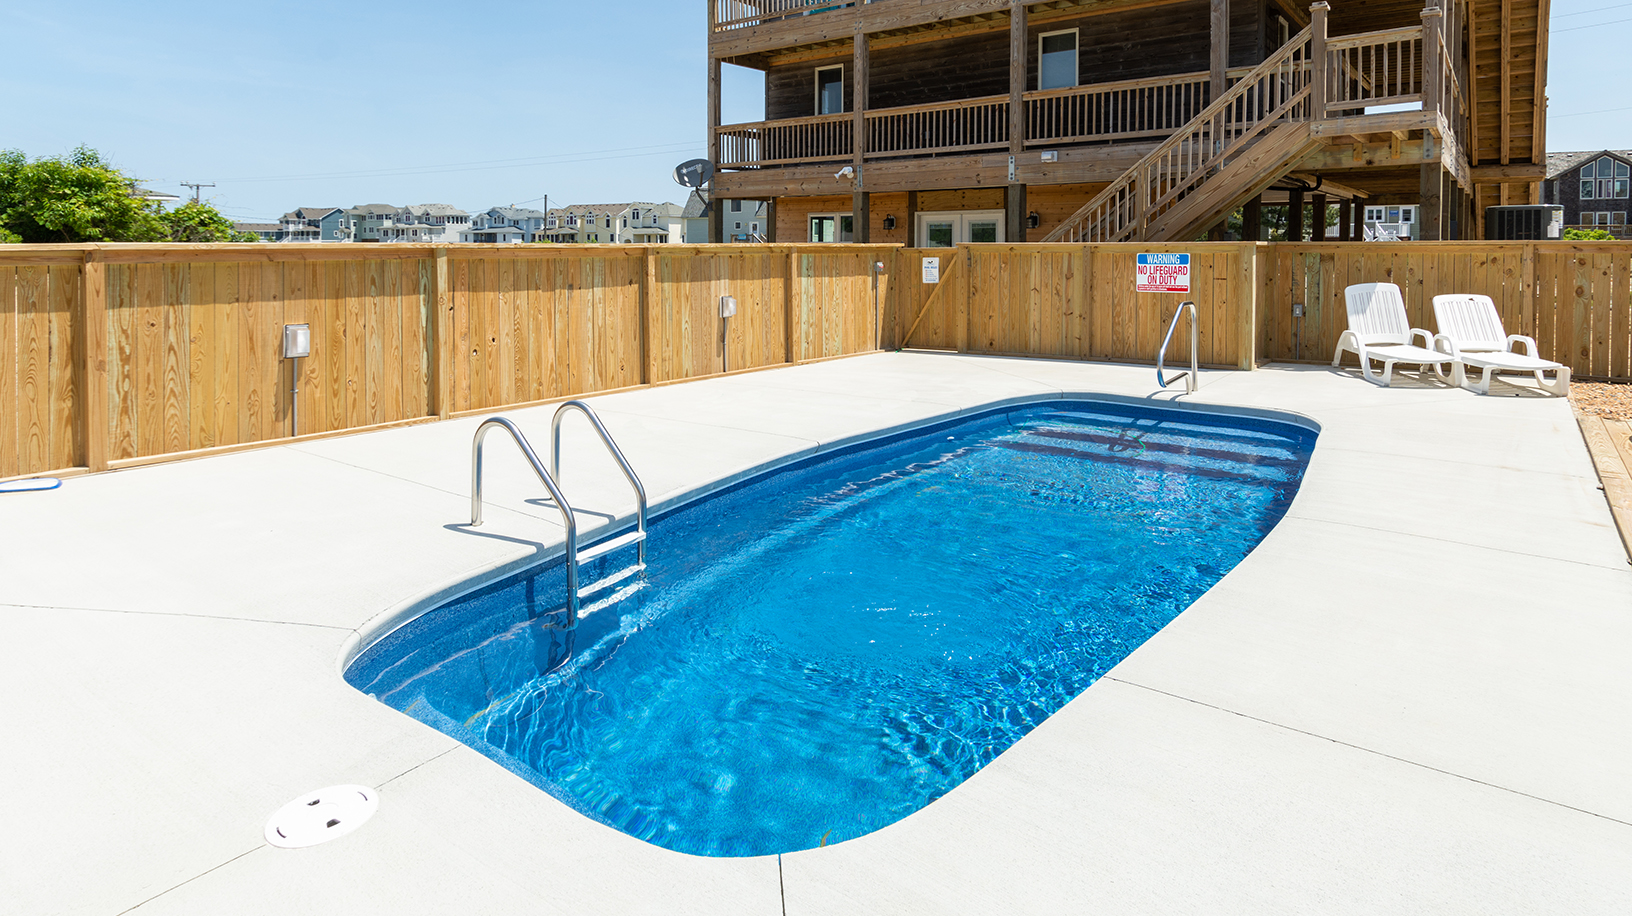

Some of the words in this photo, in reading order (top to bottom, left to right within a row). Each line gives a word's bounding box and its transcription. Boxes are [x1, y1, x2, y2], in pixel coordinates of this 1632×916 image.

[1146, 254, 1180, 264] WARNING
[1138, 265, 1148, 275] NO
[1149, 265, 1188, 276] LIFEGUARD
[1147, 275, 1157, 284] ON
[1159, 275, 1178, 285] DUTY
